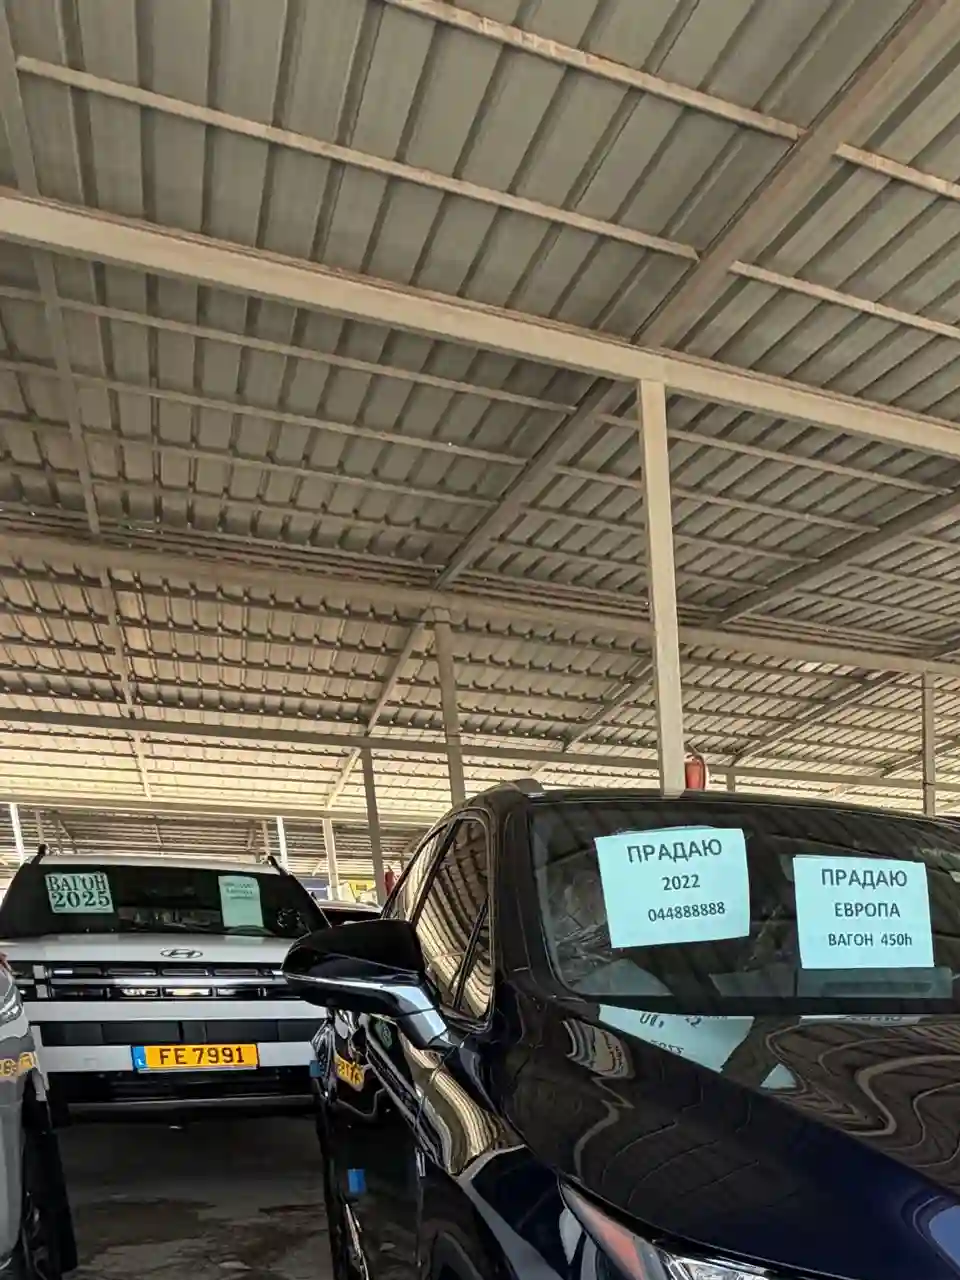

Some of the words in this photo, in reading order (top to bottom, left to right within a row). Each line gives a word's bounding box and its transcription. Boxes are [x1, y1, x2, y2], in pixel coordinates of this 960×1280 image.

[627, 839, 722, 863] ПРАДАЮ
[48, 875, 107, 892] ВАГОН
[662, 874, 700, 891] 2022
[821, 868, 908, 890] ПРАДАЮ
[52, 890, 110, 908] 2025
[648, 901, 726, 922] 044888888
[834, 902, 901, 918] ЕВРОПА
[828, 933, 874, 947] ВАГОН
[880, 932, 913, 947] 450h
[159, 1047, 189, 1065] FE
[192, 1045, 245, 1065] 7991
